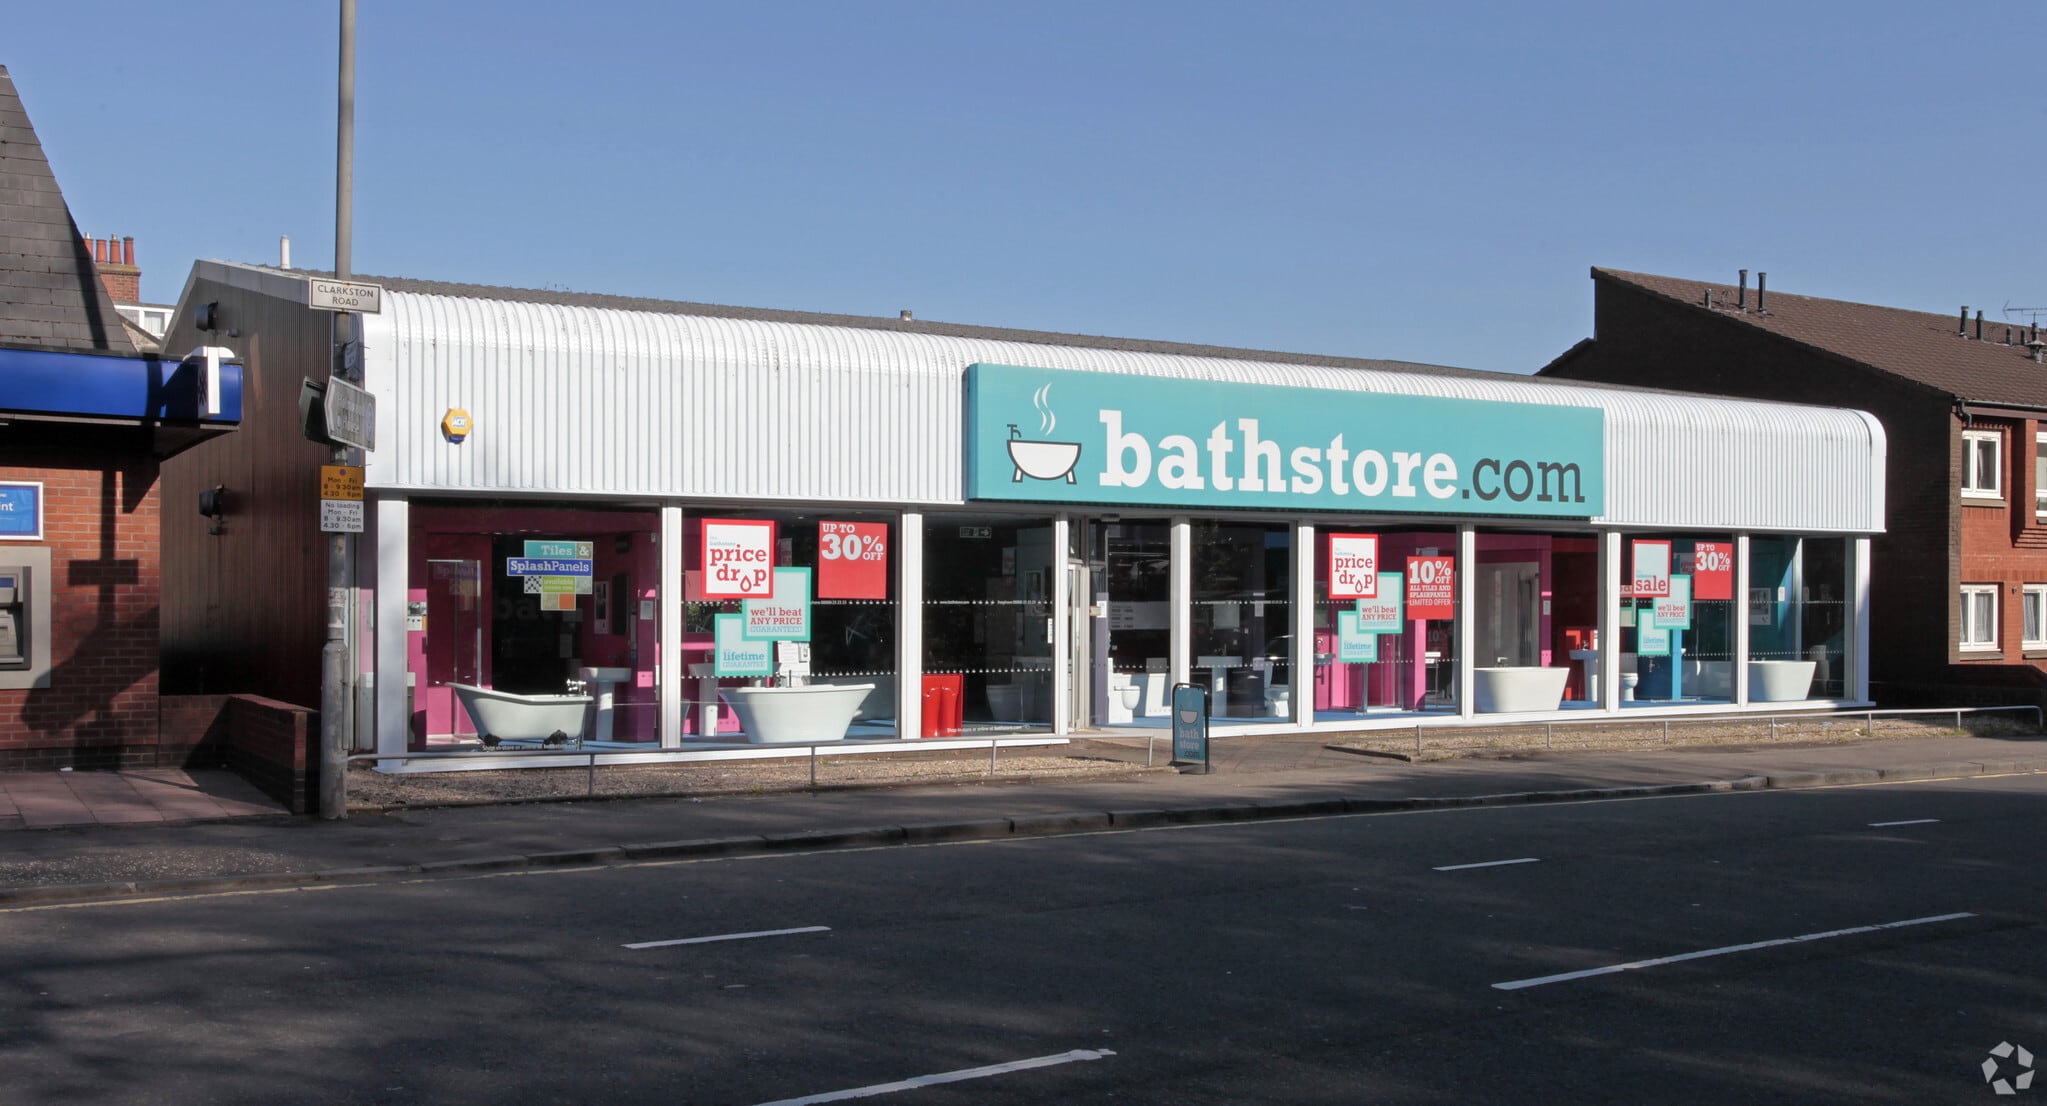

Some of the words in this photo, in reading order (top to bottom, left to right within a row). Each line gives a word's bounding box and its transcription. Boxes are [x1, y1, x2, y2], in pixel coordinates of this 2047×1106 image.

[317, 284, 374, 298] CLARKSTON
[332, 296, 359, 306] ROAD
[1099, 409, 1586, 504] bathstore.com
[0, 502, 14, 512] nt
[822, 523, 838, 533] UP
[839, 523, 856, 534] TO
[541, 544, 573, 556] Tiles
[579, 545, 589, 556] &
[821, 533, 884, 560] 30%
[1696, 543, 1706, 551] UP
[1705, 543, 1716, 552] TO
[709, 543, 767, 567] price
[862, 551, 884, 561] OFF
[510, 560, 590, 573] SplashPanels
[1334, 553, 1374, 573] price
[1695, 551, 1731, 572] 30%
[1409, 560, 1452, 585] 10%
[1718, 564, 1730, 572] OFF
[716, 563, 767, 593] drop
[1338, 569, 1374, 594] drop
[1434, 575, 1452, 585] OFF
[1635, 574, 1667, 592] sale
[750, 607, 777, 617] we'll
[779, 607, 802, 617] beat
[1362, 605, 1380, 613] we'll
[1381, 605, 1397, 613] beat
[750, 617, 772, 625] ANY
[773, 617, 802, 625] PRICE
[1361, 613, 1377, 621] ANY
[1377, 613, 1397, 621] PRICE
[722, 651, 766, 661] lifetime
[1179, 728, 1200, 739] bath
[1179, 740, 1200, 749] store
